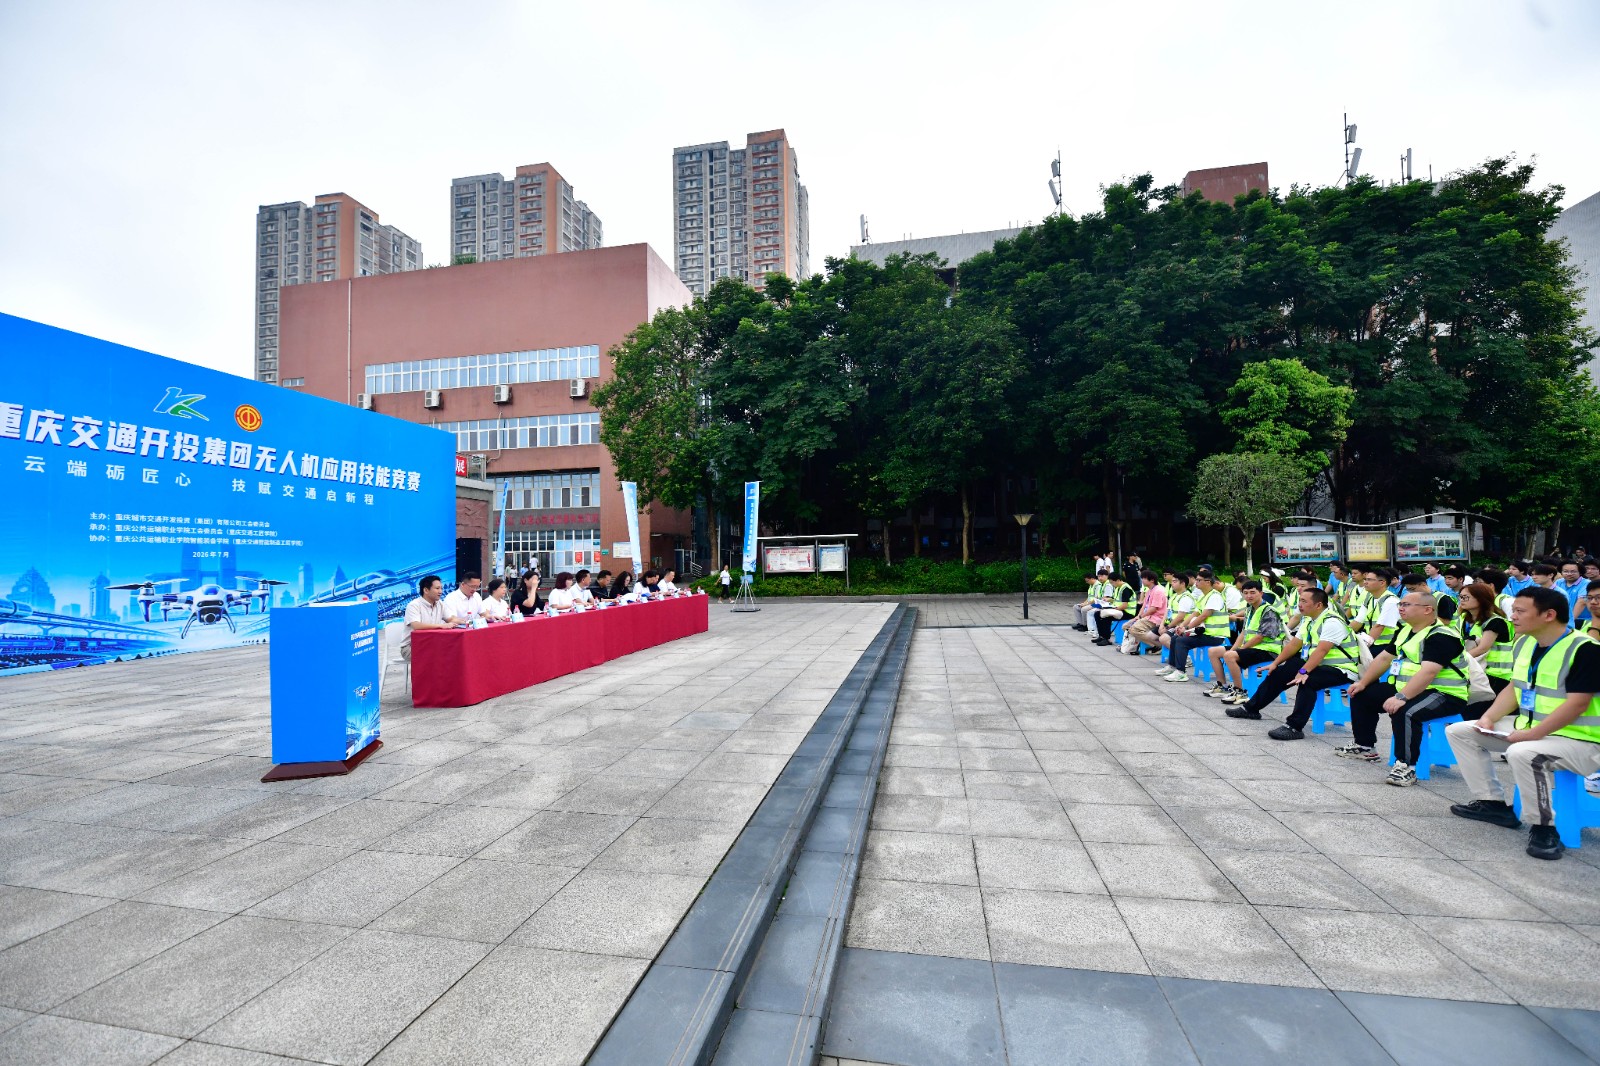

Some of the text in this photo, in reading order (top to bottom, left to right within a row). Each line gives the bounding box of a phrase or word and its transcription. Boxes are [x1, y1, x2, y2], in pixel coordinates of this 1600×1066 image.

[24, 455, 375, 505] 云端砺匠心 技赋交通启新程
